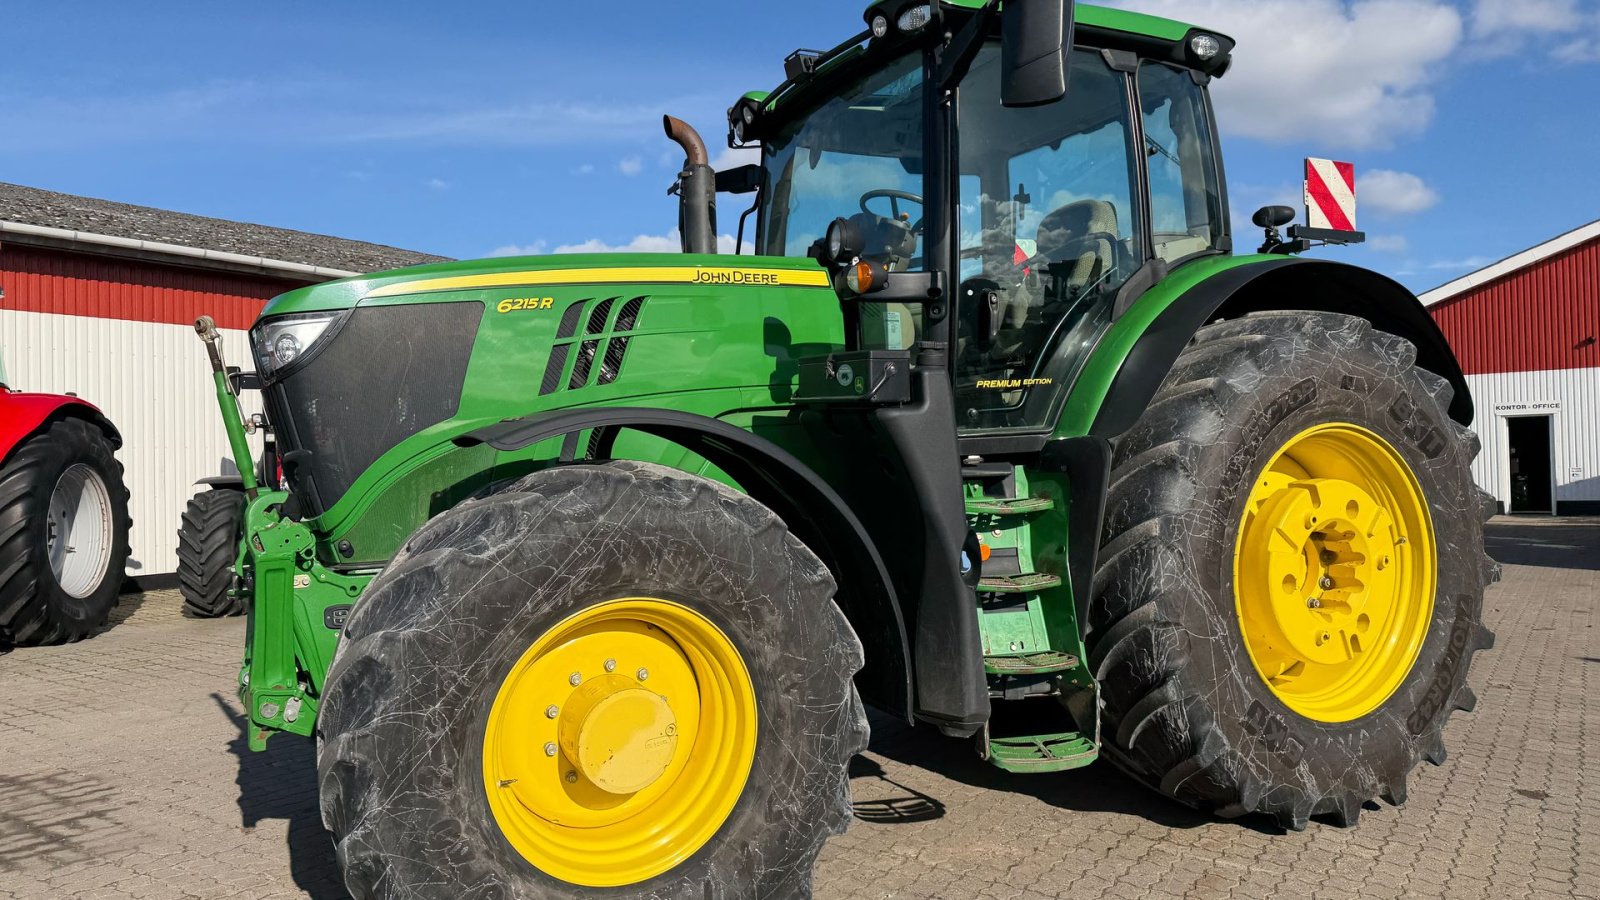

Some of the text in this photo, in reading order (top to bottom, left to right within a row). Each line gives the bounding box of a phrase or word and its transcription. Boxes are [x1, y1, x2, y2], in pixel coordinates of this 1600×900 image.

[692, 270, 778, 283] JOHN DEERE
[496, 296, 554, 314] 6215 R
[976, 379, 1021, 388] PREMIUM
